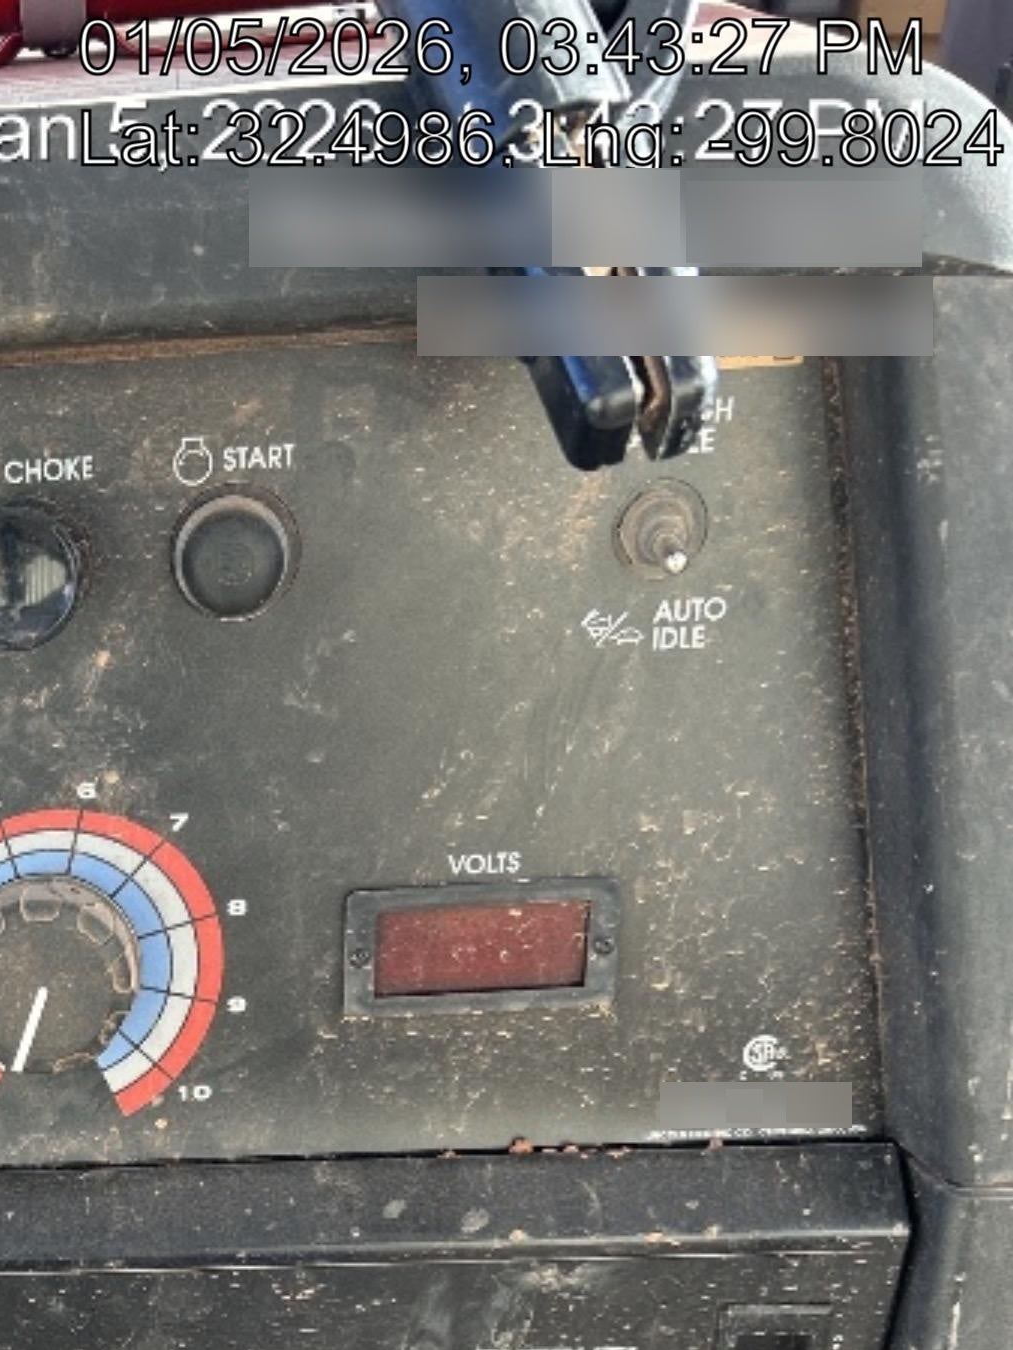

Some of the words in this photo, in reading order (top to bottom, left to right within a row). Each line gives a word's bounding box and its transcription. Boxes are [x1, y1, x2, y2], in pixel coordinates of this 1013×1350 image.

[223, 443, 296, 471] START
[4, 454, 94, 485] CHOKE
[653, 597, 728, 624] AUTO
[652, 626, 707, 651] IDLE
[76, 783, 98, 800] 6
[169, 813, 189, 832] 7
[448, 851, 523, 875] VOLTS
[227, 900, 248, 916] 8
[227, 998, 248, 1013] 9
[177, 1084, 213, 1101] 10
